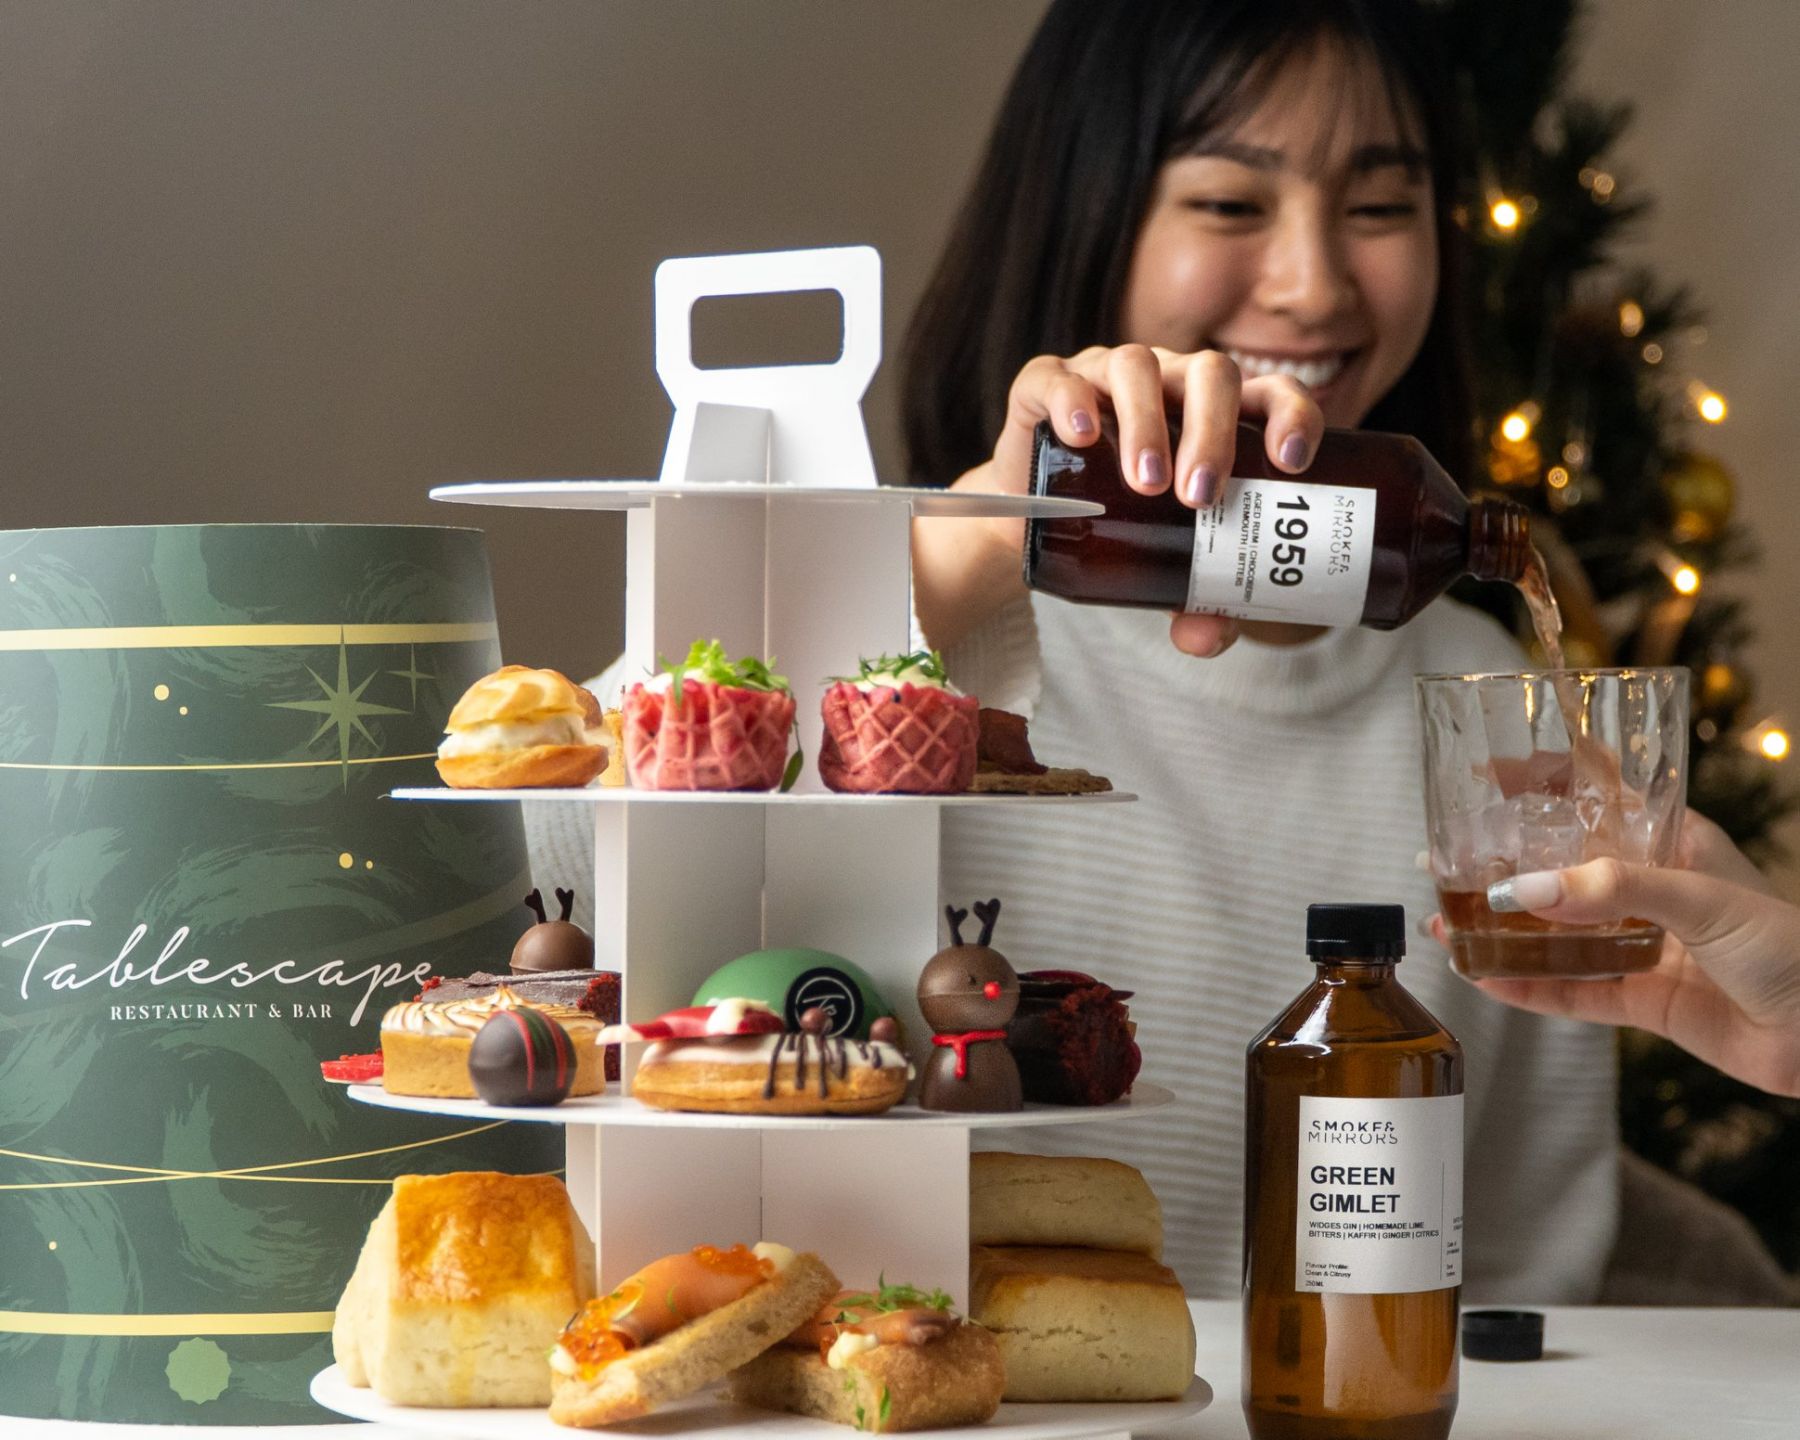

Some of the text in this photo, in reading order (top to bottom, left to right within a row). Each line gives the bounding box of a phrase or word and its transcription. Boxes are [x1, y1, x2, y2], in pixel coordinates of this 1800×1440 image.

[1252, 491, 1263, 519] AGED
[1235, 491, 1252, 587] VERMOUTH BITTERS
[1251, 519, 1261, 543] RUM
[1269, 494, 1311, 587] 1959
[2, 919, 432, 1027] Tablescape
[110, 1003, 333, 1021] RESTAURANT & BAR
[1308, 1131, 1399, 1145] MIRRORS
[1310, 1165, 1395, 1186] GREEN
[1309, 1193, 1400, 1213] GIMLET
[1308, 1230, 1342, 1239] BITTERS
[1347, 1231, 1377, 1239] KAFFIR
[1382, 1231, 1411, 1239] GINGER
[1309, 1221, 1425, 1230] WIDGES GIN HOMEMADE LIME
